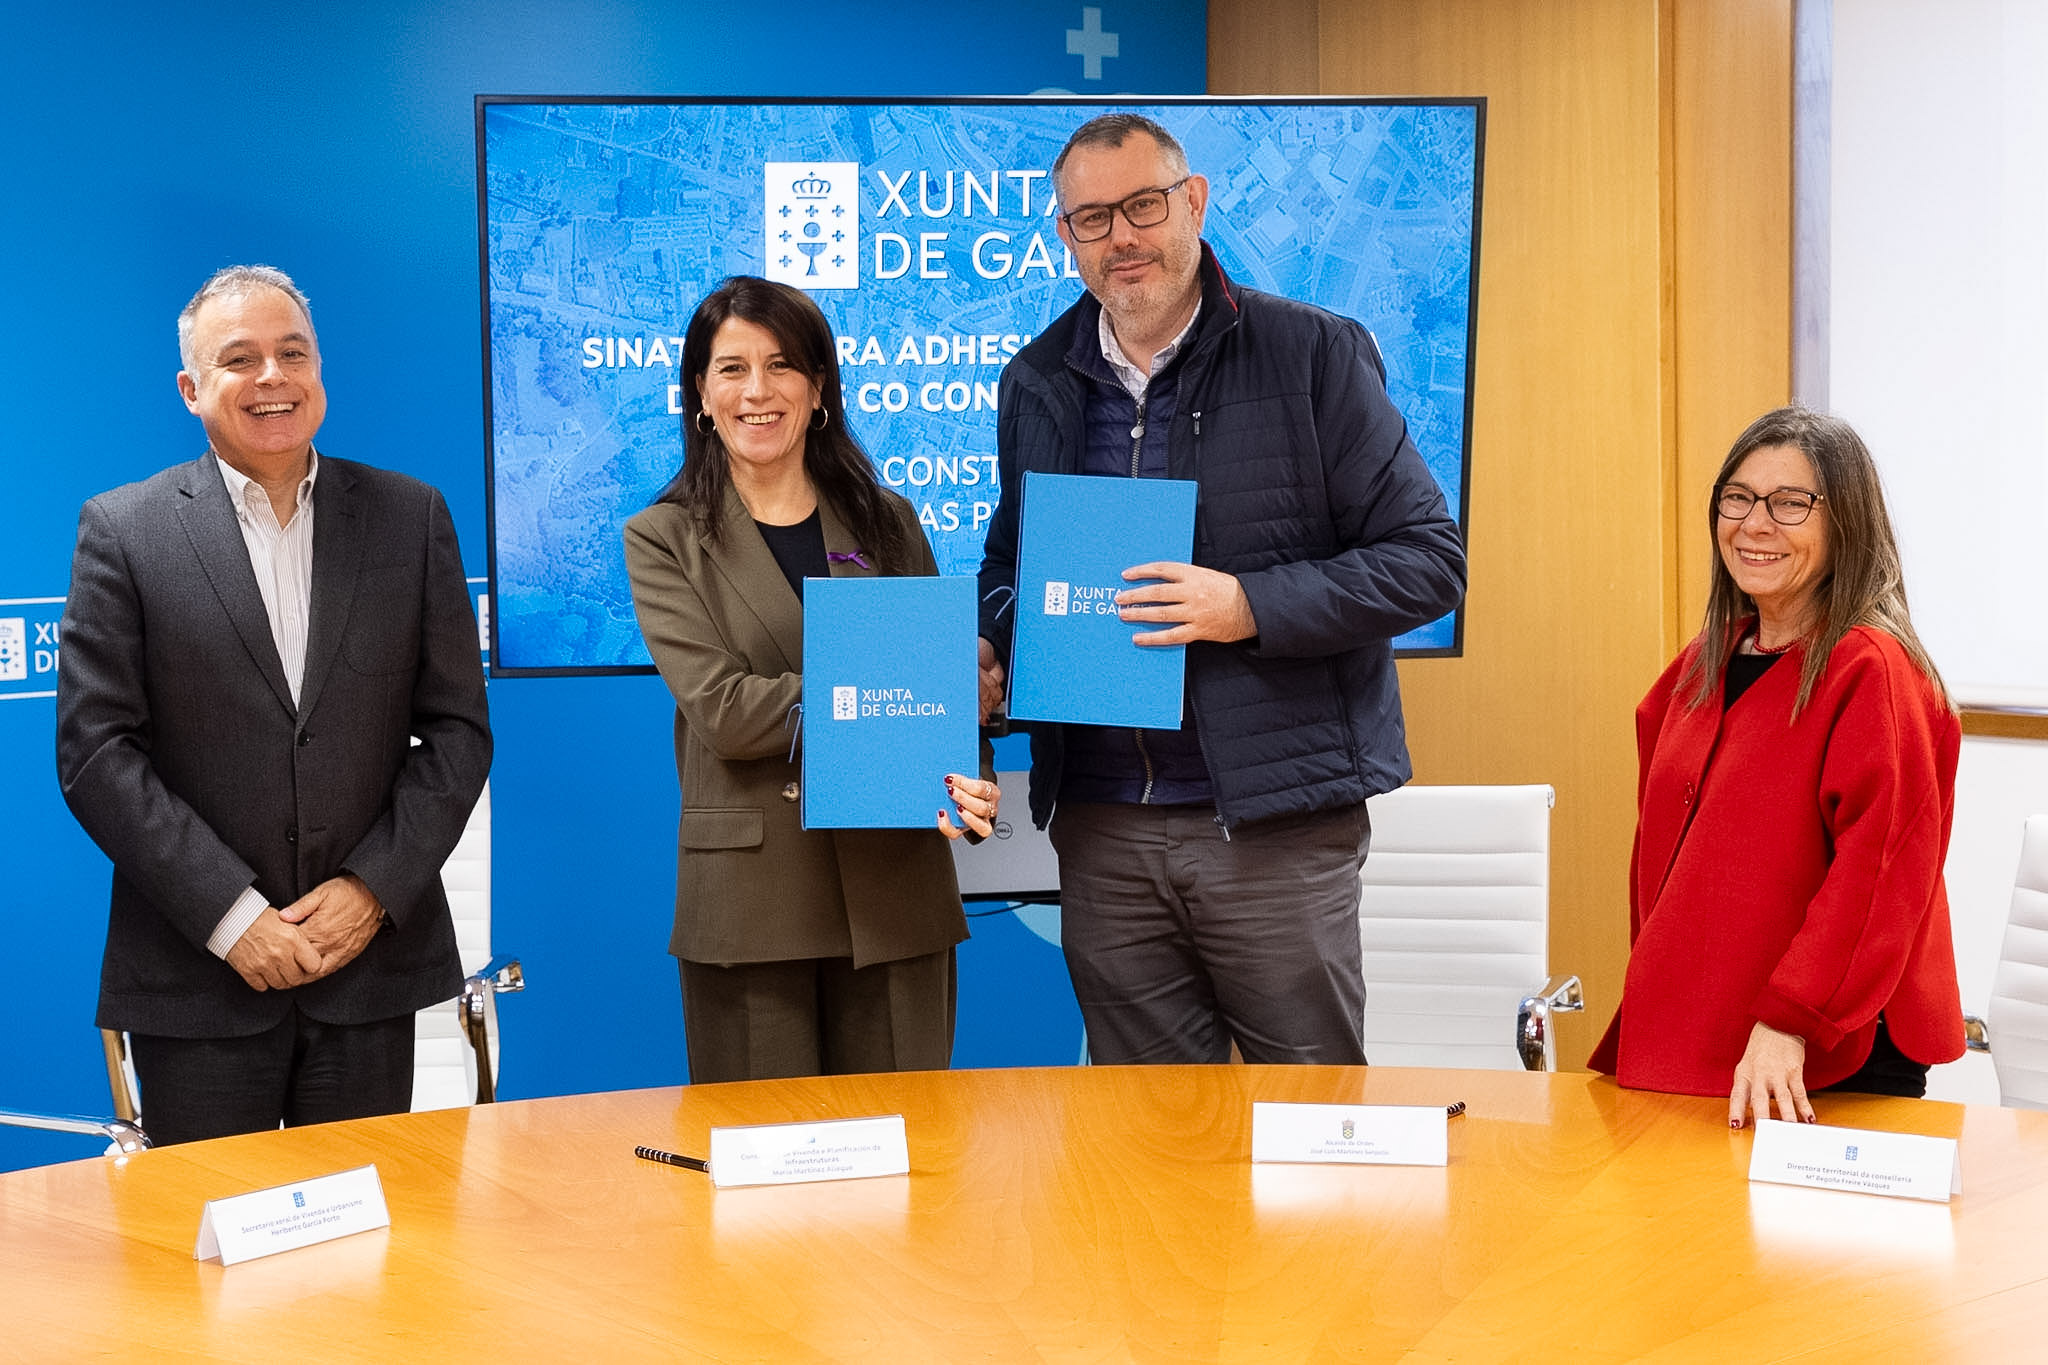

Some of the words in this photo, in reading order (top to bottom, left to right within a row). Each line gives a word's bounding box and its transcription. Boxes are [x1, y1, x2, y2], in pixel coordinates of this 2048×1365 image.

[876, 233, 949, 279] DE
[858, 382, 909, 413] CO
[1072, 601, 1091, 614] DE
[862, 689, 914, 702] XUNTA
[862, 704, 881, 717] DE
[886, 703, 946, 717] GALICIA
[1787, 1162, 1821, 1173] Directora
[1822, 1166, 1859, 1178] territorial
